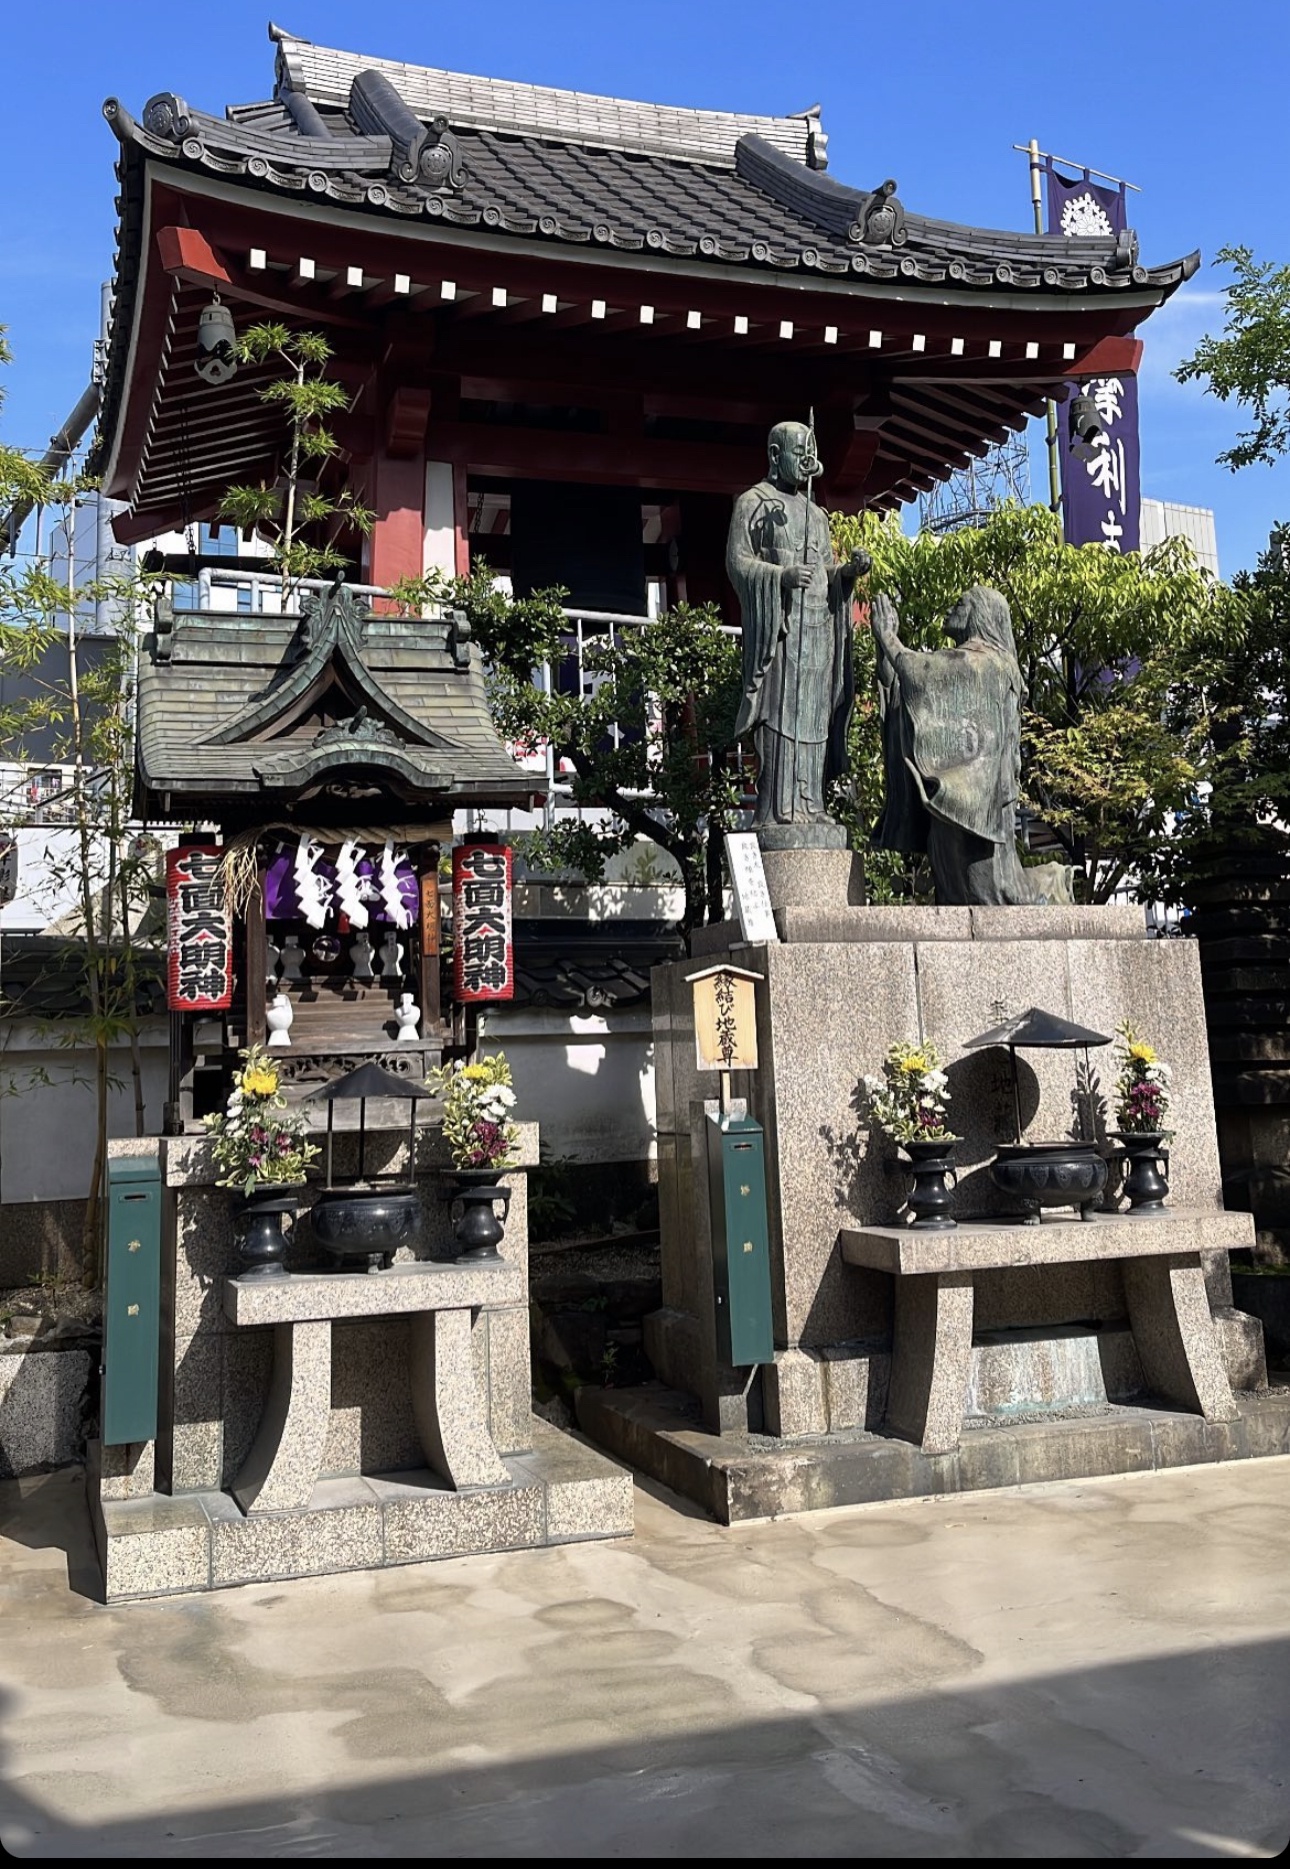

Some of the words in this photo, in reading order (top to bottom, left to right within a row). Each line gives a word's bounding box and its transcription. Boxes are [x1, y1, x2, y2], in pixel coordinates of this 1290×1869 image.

[174, 851, 227, 1001] 七面大明神
[461, 850, 506, 993] 七面大明神
[713, 971, 739, 1068] 縁結び地蔵尊
